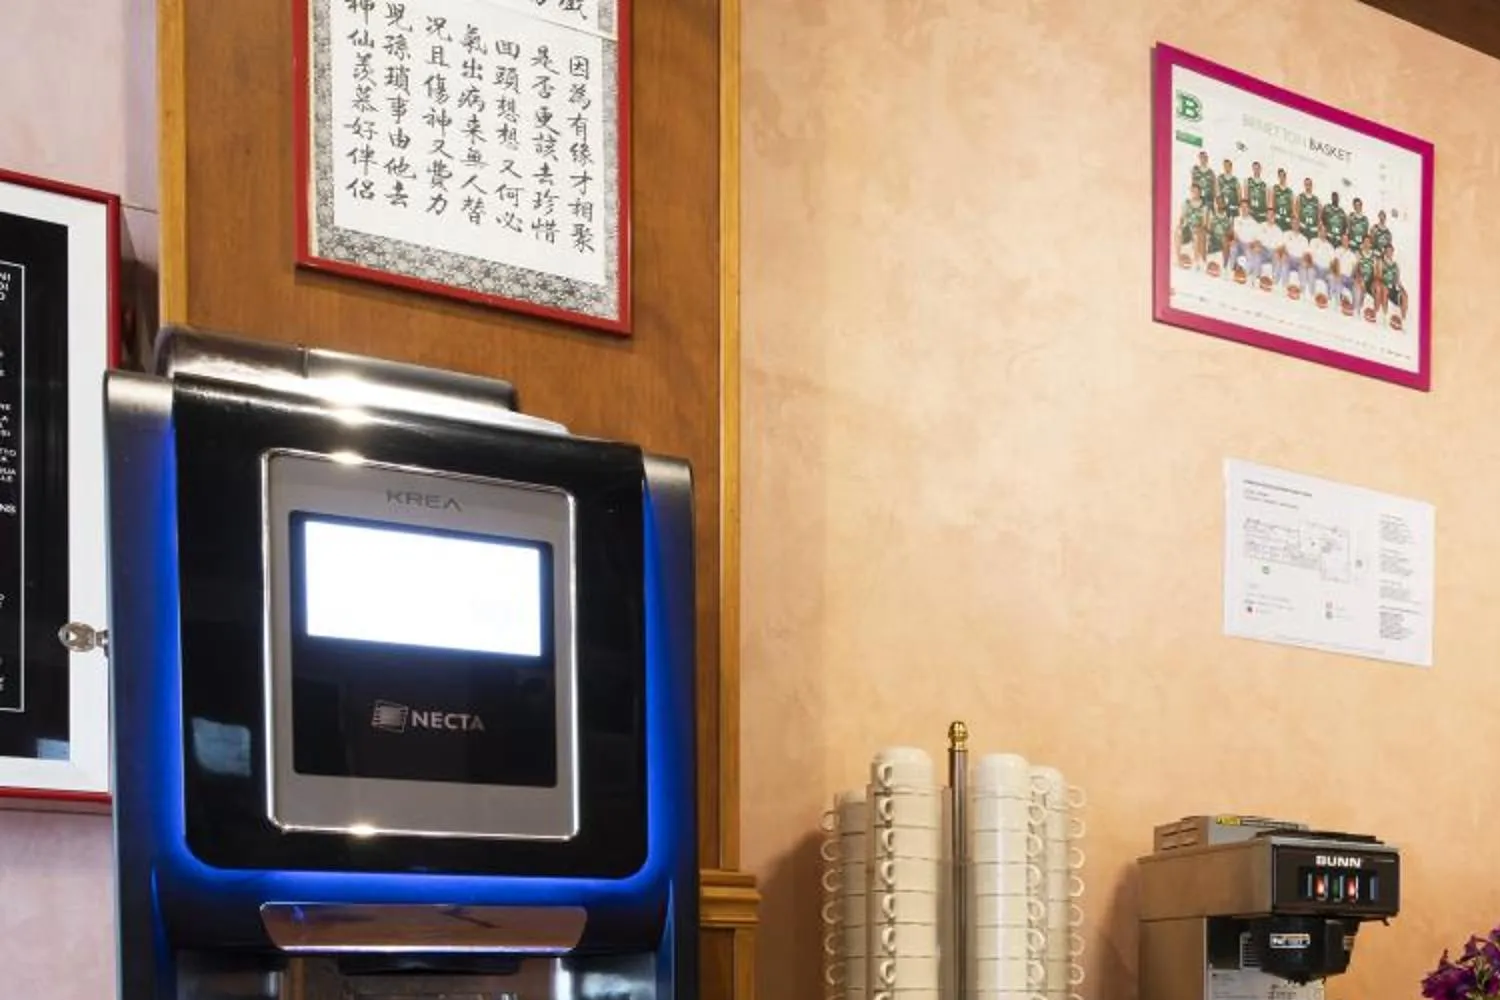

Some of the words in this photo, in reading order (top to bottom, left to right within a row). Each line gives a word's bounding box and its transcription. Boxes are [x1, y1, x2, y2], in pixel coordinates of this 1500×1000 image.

[1309, 136, 1353, 163] BASKET
[386, 489, 463, 512] KREA
[411, 709, 485, 731] NECTA
[1315, 855, 1361, 868] BUNN
